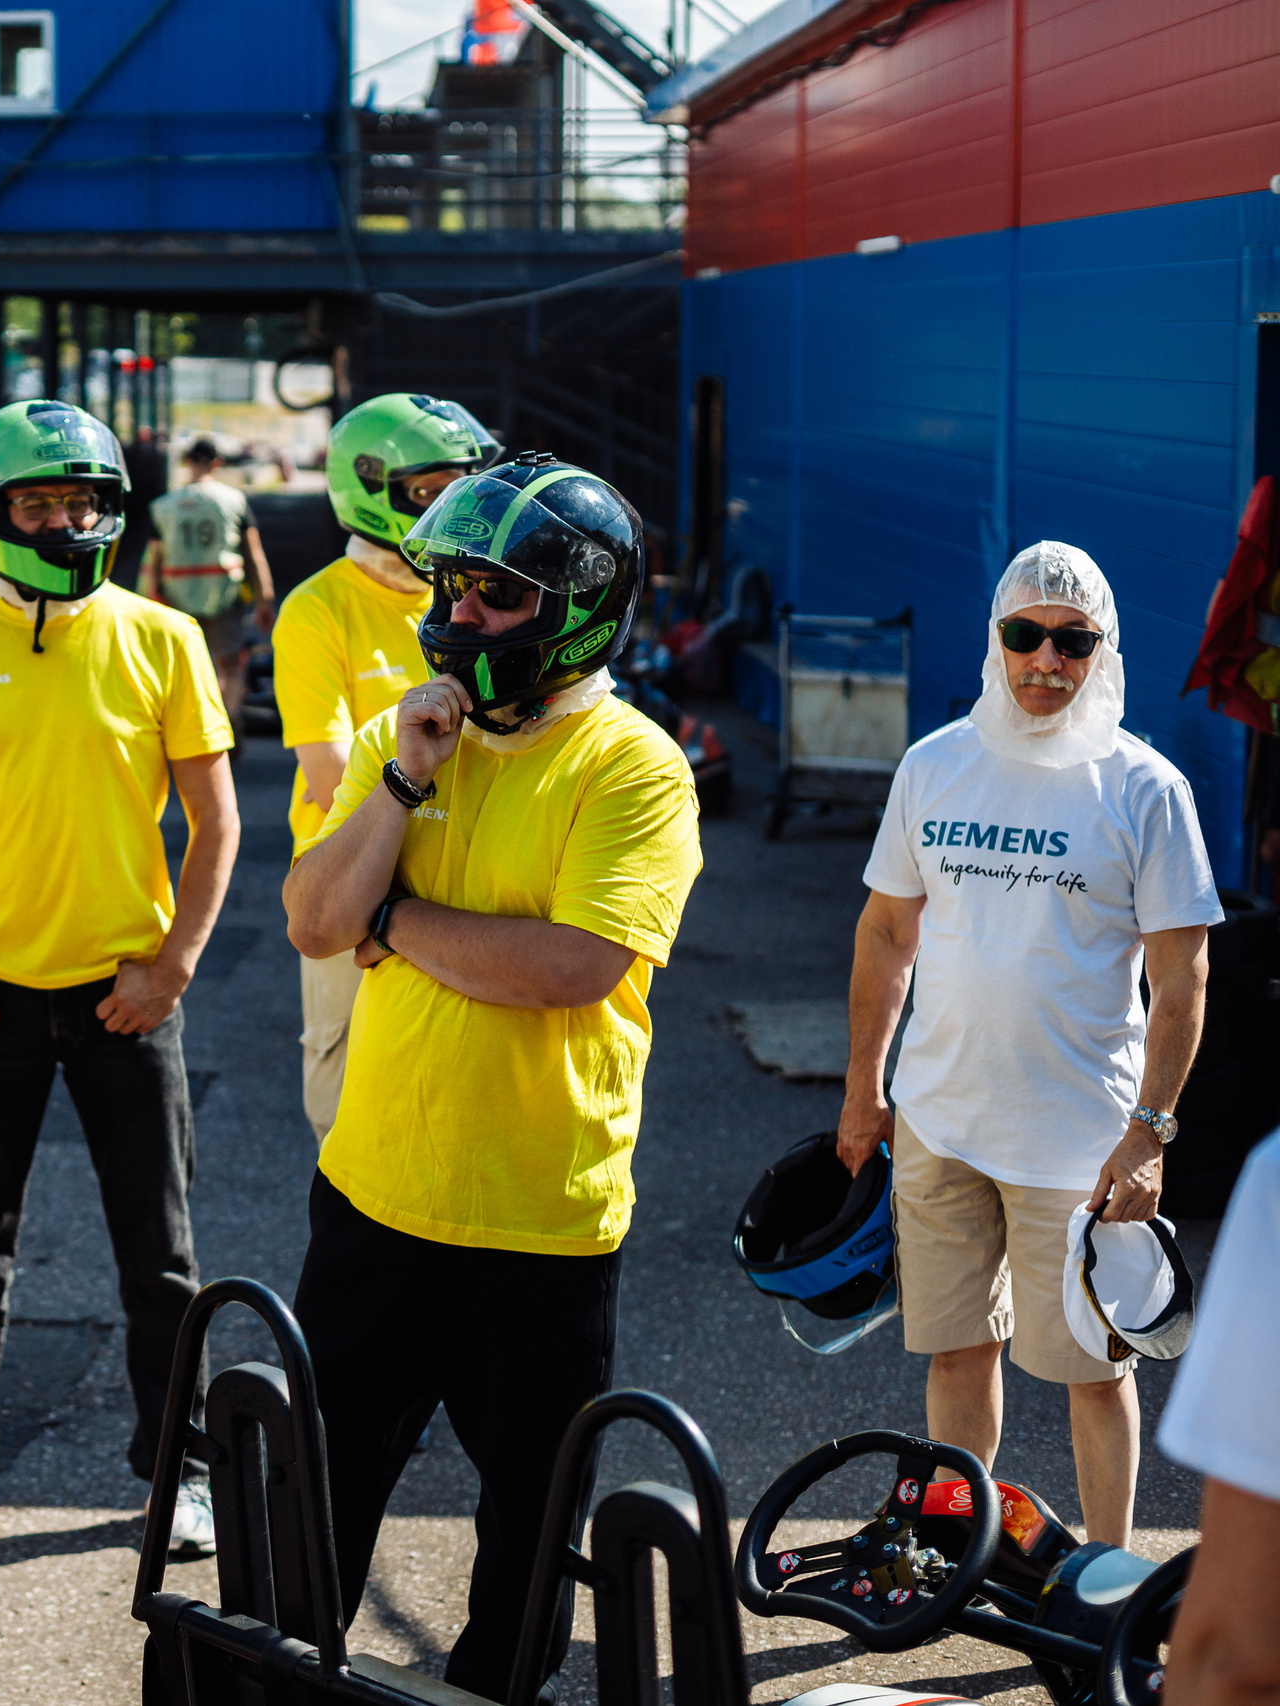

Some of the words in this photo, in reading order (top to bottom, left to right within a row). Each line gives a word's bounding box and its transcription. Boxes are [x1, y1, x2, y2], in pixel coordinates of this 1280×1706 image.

[180, 518, 217, 547] 19
[568, 626, 610, 660] GSB
[922, 820, 1069, 857] SIEMENS
[940, 856, 1022, 892] Ingenuity
[1024, 866, 1054, 887] for
[1056, 870, 1089, 894] life
